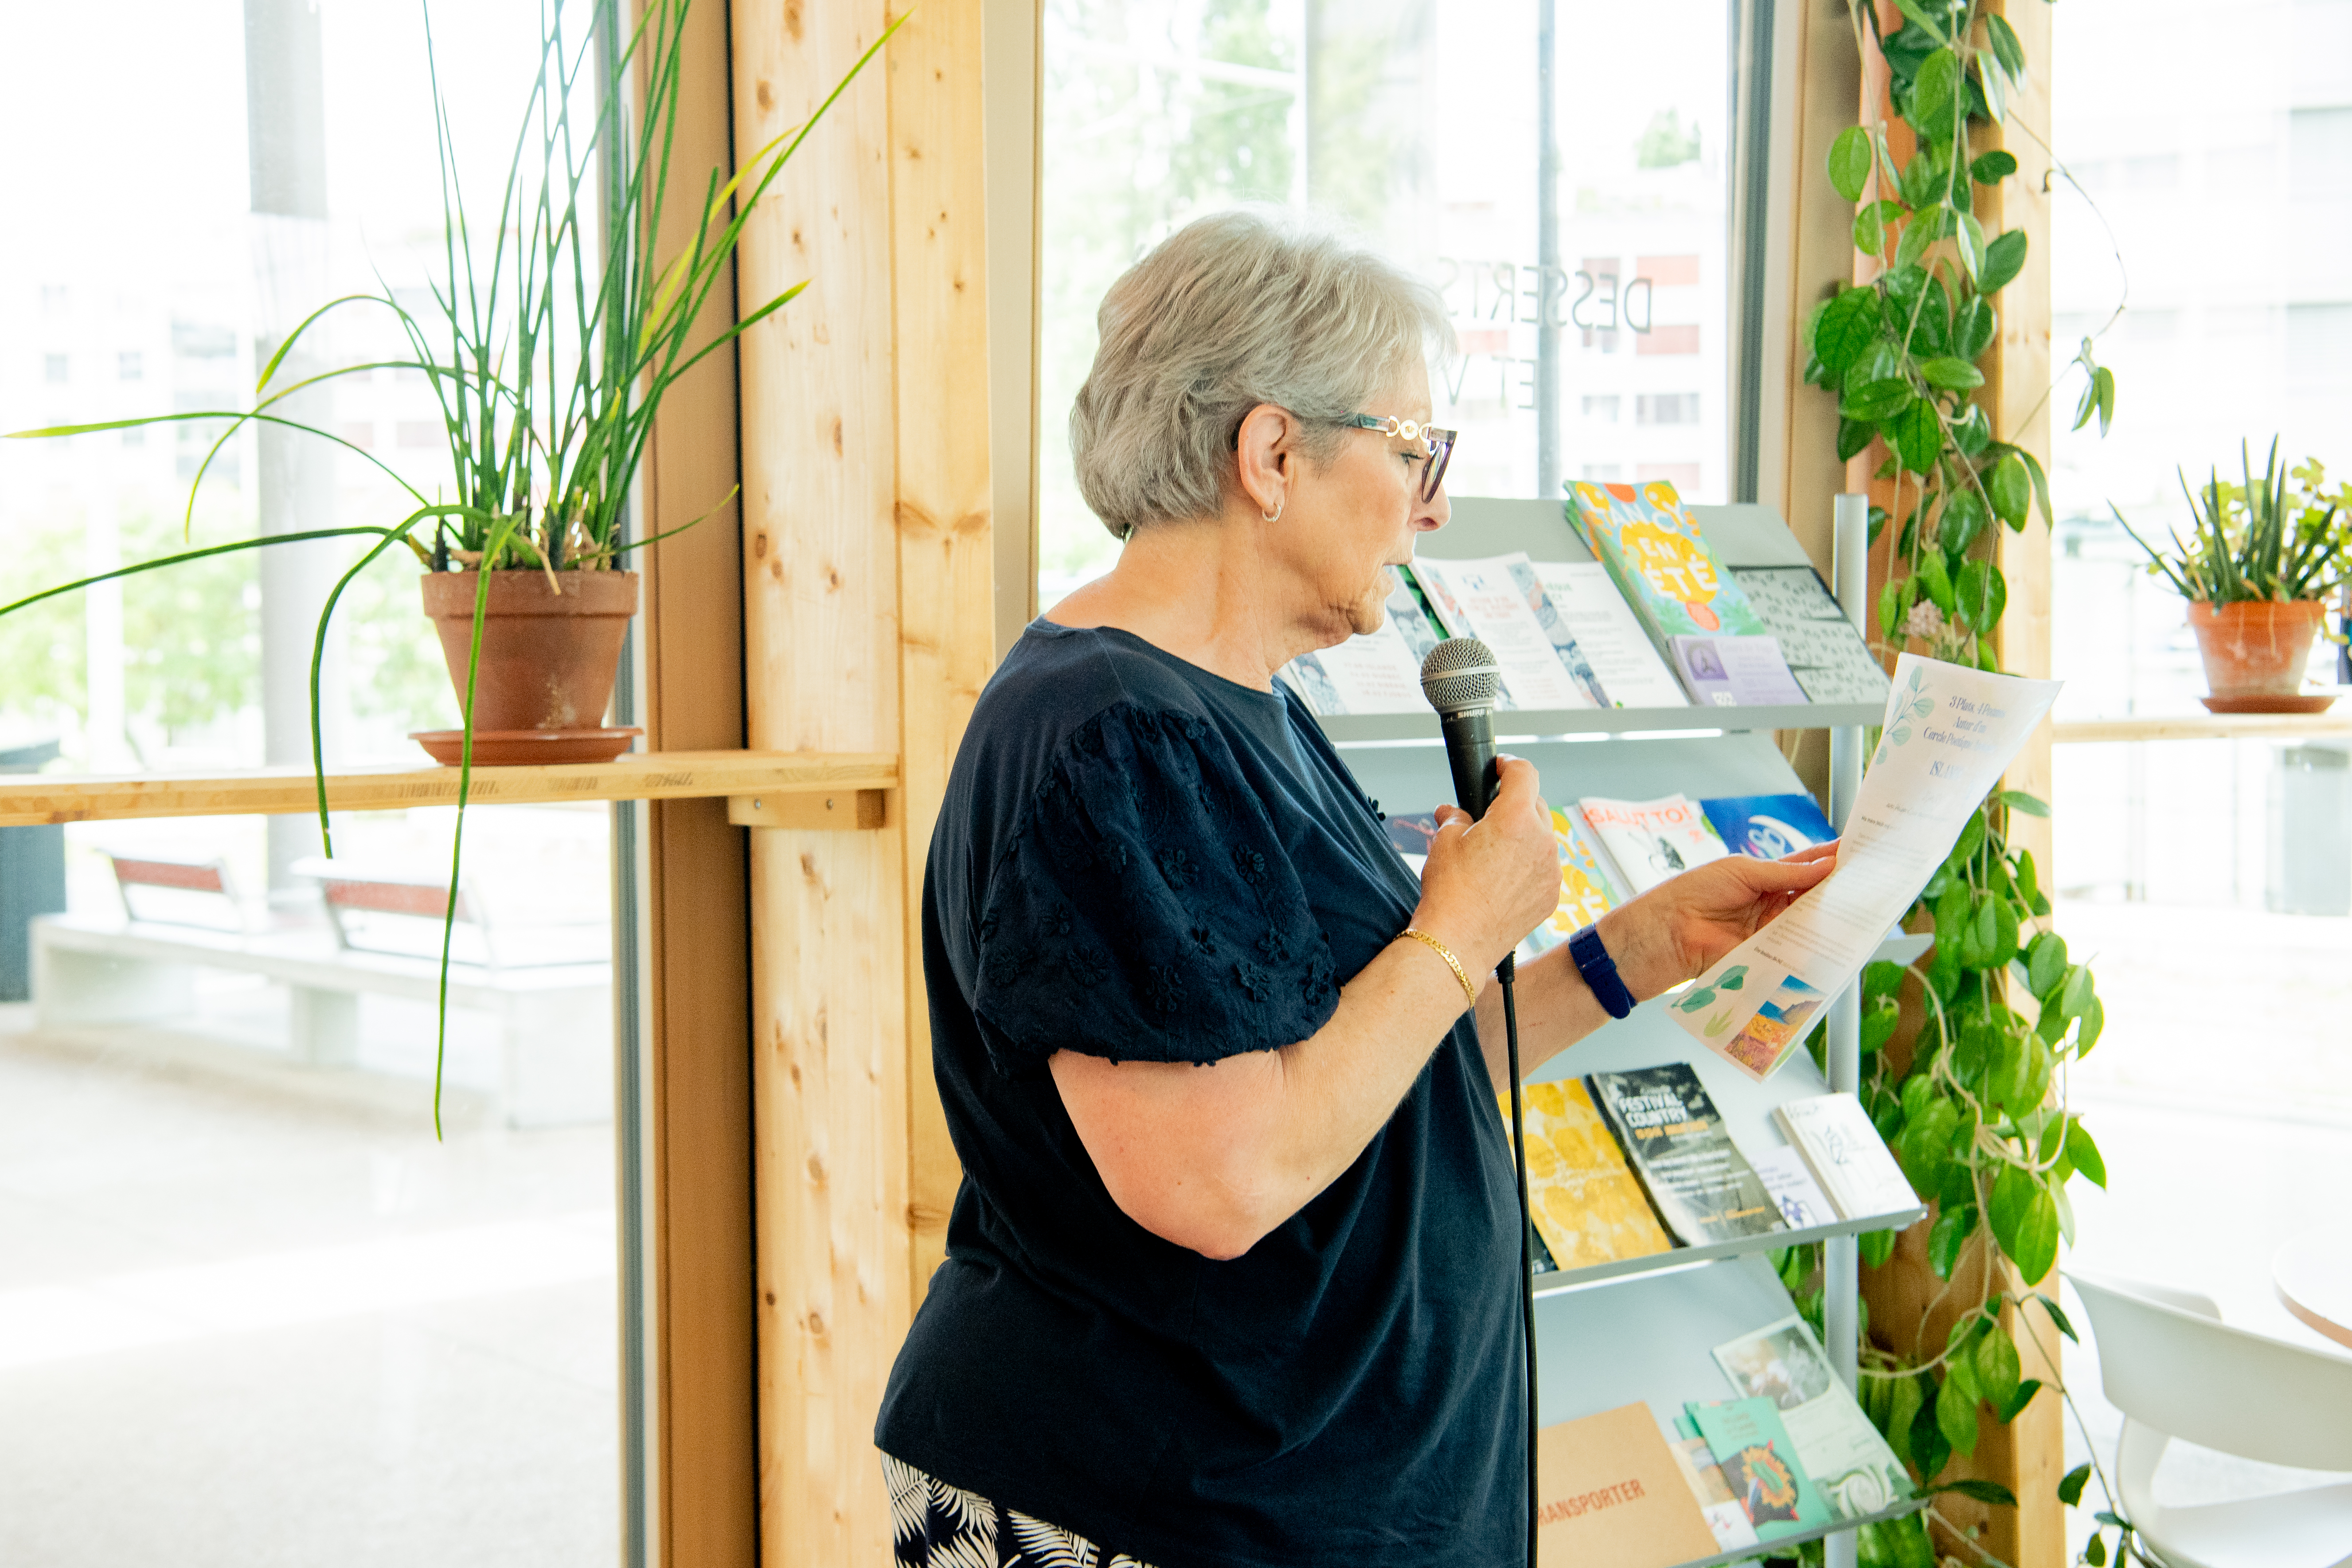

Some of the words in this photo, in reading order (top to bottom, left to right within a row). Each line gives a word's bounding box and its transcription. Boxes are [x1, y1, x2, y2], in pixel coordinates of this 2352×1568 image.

[1580, 489, 1684, 534] LANCY
[1638, 537, 1678, 560] EN
[1645, 555, 1719, 598] ÉTÉ
[1618, 1093, 1684, 1112] FESTIVAL
[1626, 1107, 1688, 1128] COUNTRY
[1539, 1479, 1645, 1527] RANSPORTER
